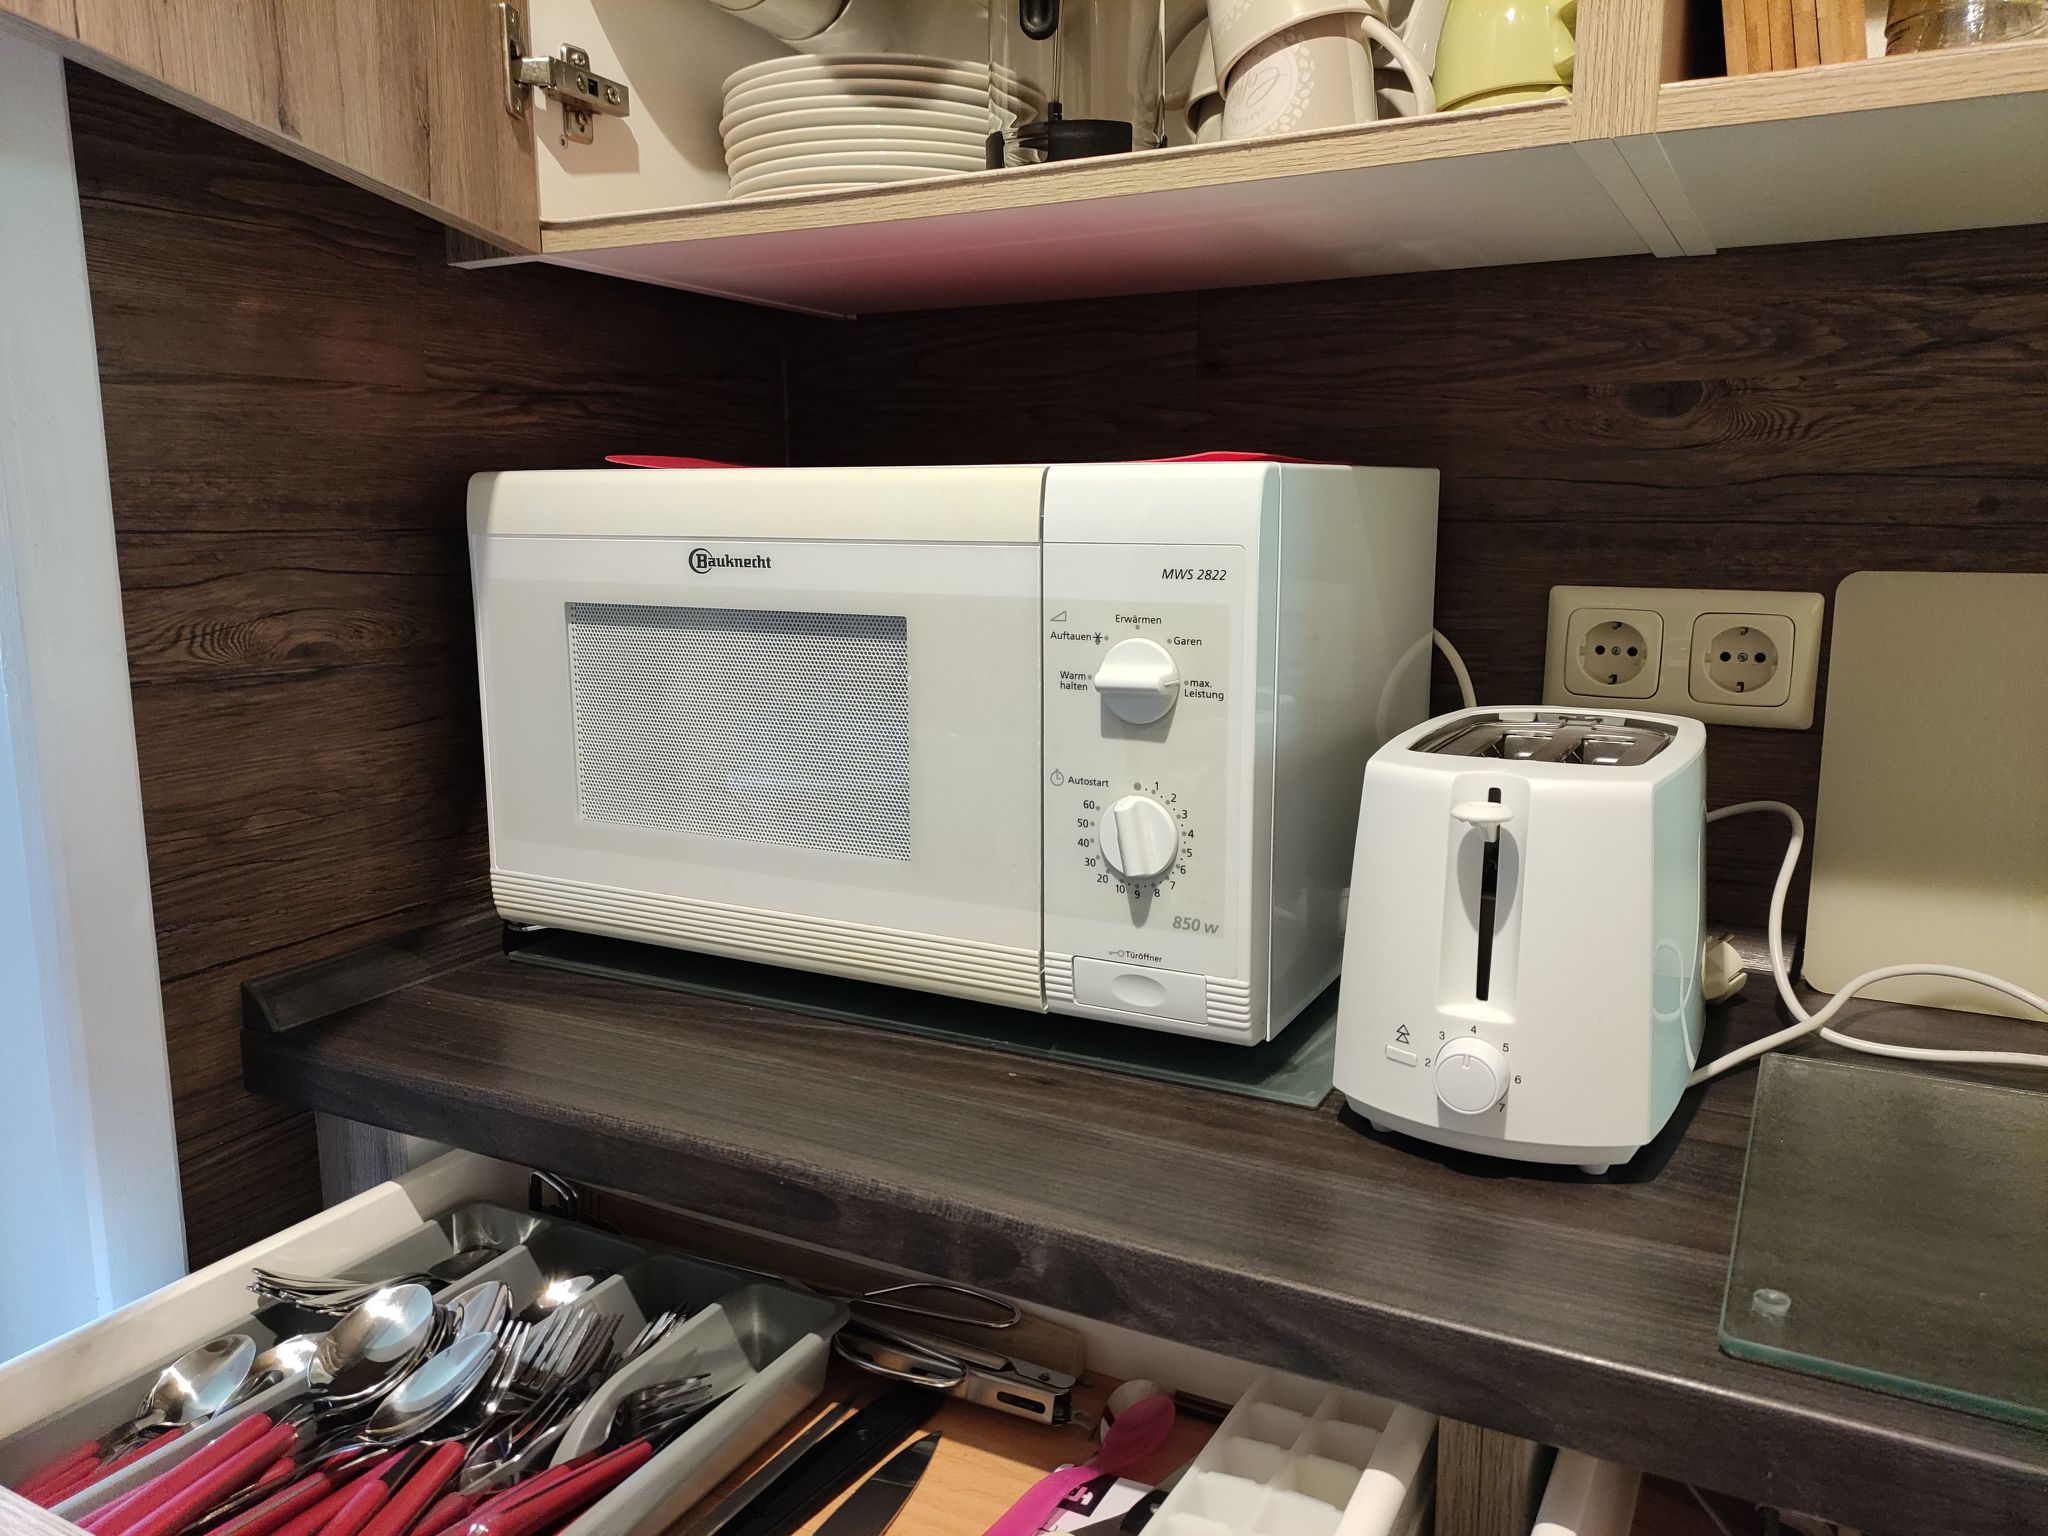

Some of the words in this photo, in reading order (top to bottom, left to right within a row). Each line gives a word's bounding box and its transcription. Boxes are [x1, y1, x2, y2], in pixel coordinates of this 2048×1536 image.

[690, 549, 771, 573] Bauknecht
[1162, 569, 1193, 580] MWS
[1197, 569, 1227, 581] 2822
[1115, 614, 1162, 624] Erwärmen
[1050, 632, 1092, 641] Auftauen
[1173, 637, 1202, 646] Garen
[1060, 671, 1086, 680] Warm
[1060, 681, 1088, 690] halten
[1190, 680, 1213, 688] max.
[1184, 690, 1224, 701] Leistung
[1068, 776, 1109, 787] Autostart
[1155, 782, 1159, 790] 1
[1171, 794, 1177, 802] 2
[1083, 801, 1095, 809] 60
[1182, 810, 1187, 819] 3
[1077, 819, 1089, 828] 50
[1188, 830, 1194, 838] 4
[1077, 839, 1089, 847] 40
[1187, 849, 1192, 858] 5
[1085, 858, 1096, 867] 30
[1180, 865, 1186, 874] 6
[1097, 875, 1108, 883] 20
[1116, 885, 1125, 894] 10
[1170, 881, 1176, 890] 7
[1134, 890, 1140, 899] 9
[1154, 889, 1160, 897] 8
[1172, 916, 1201, 932] 850
[1126, 951, 1163, 963] Türöffner
[1470, 1025, 1477, 1034] 4
[1439, 1031, 1445, 1040] 3
[1502, 1043, 1509, 1052] 5
[1425, 1058, 1431, 1067] 2
[1515, 1075, 1521, 1084] 6
[1498, 1103, 1506, 1112] 7
